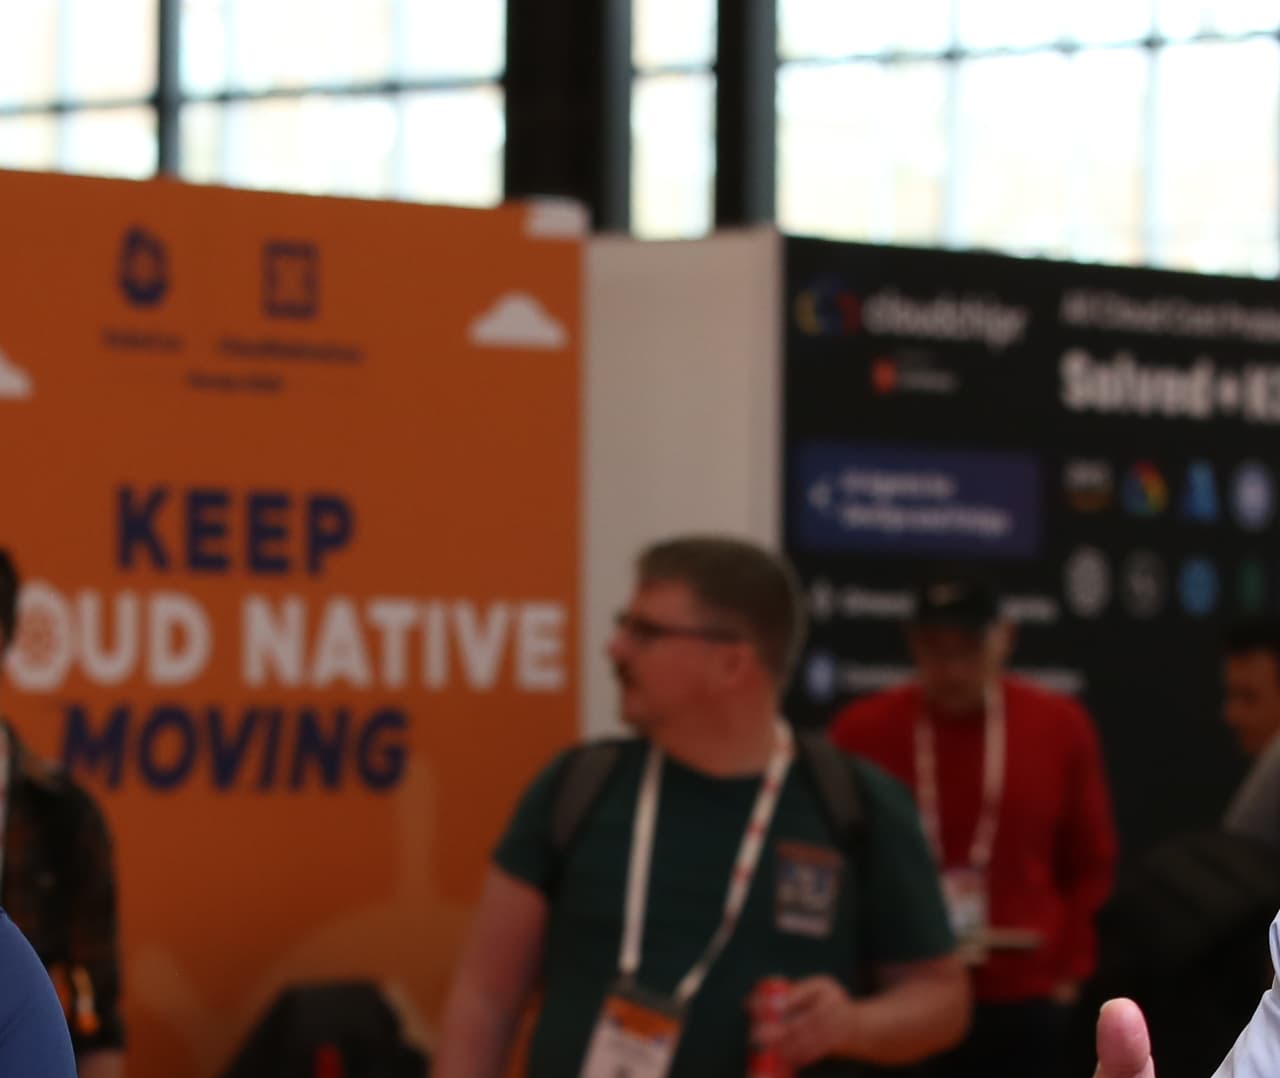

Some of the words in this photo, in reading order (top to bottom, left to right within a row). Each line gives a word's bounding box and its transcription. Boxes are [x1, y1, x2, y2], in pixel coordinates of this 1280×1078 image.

[115, 486, 355, 576] KEEP
[5, 580, 213, 692] OUD
[242, 594, 568, 692] NATIVE
[63, 703, 411, 793] MOVING
